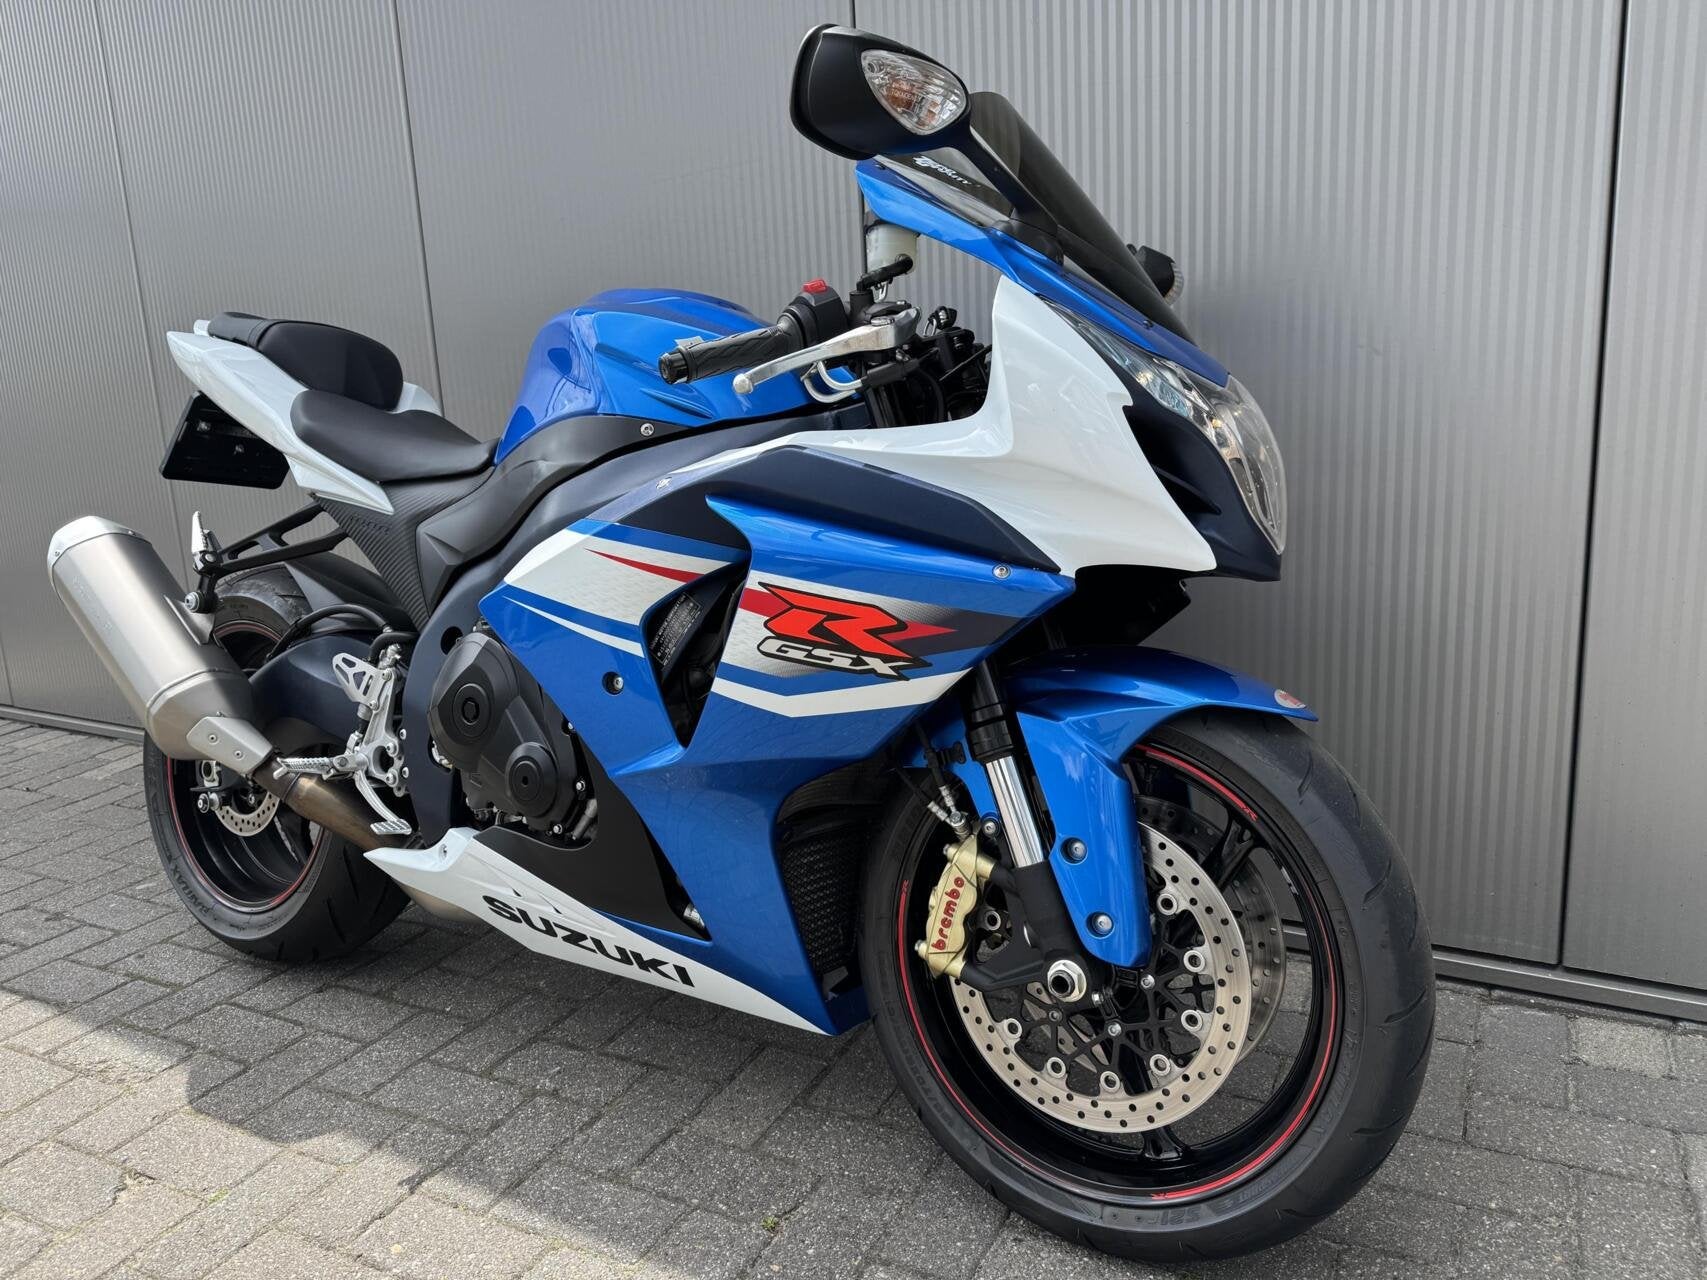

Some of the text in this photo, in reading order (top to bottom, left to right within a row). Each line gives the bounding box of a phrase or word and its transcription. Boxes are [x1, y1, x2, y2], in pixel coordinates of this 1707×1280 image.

[758, 637, 914, 679] GSX
[759, 583, 915, 660] R
[482, 895, 695, 988] SUZUKI
[931, 876, 965, 951] brembo
